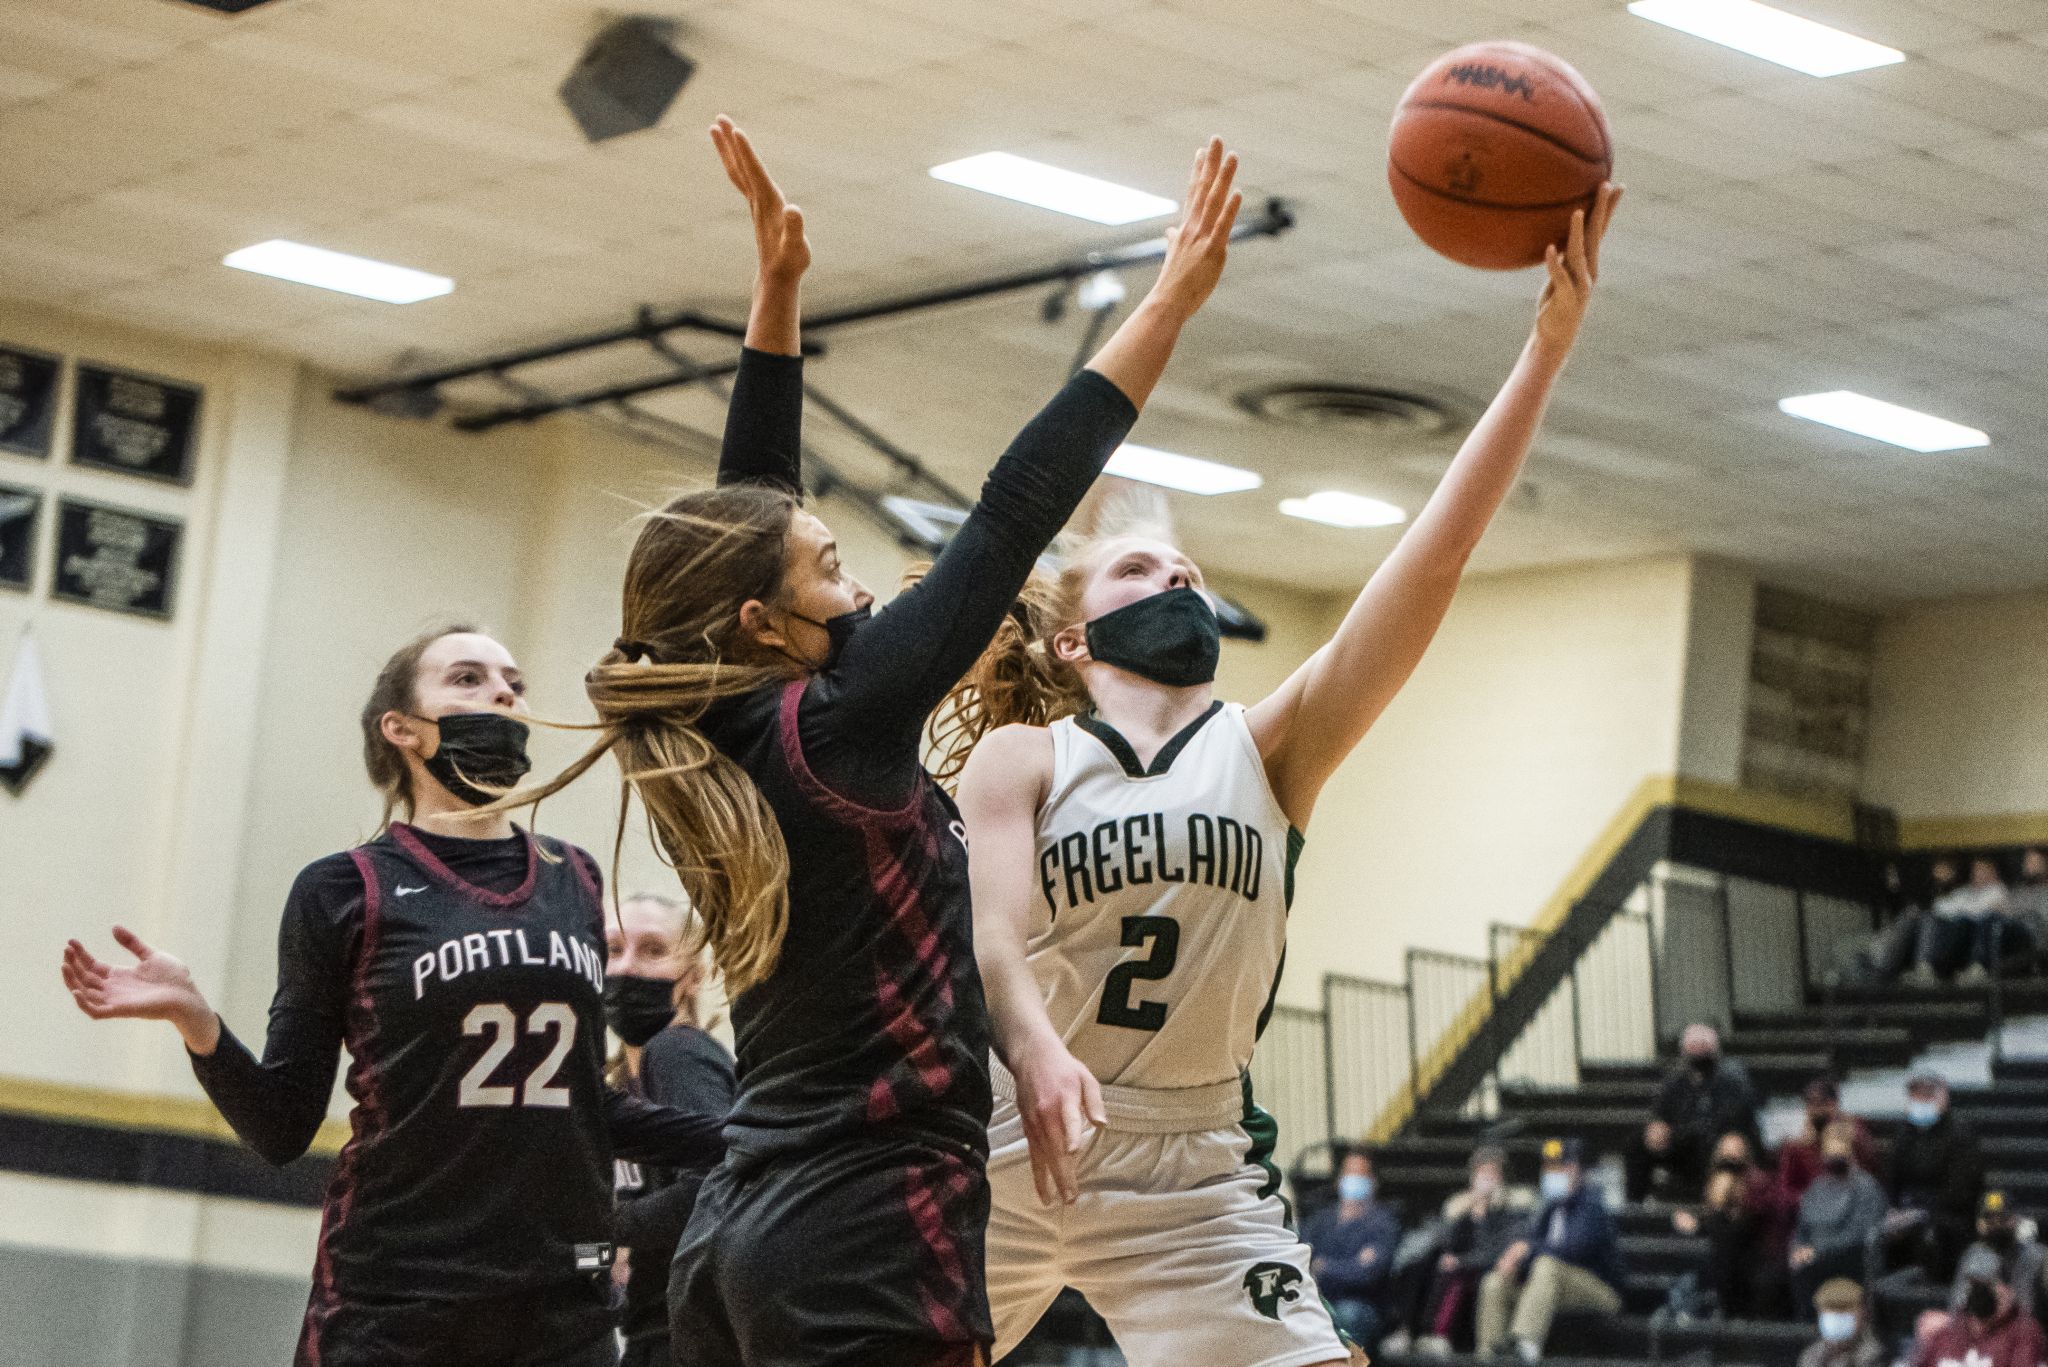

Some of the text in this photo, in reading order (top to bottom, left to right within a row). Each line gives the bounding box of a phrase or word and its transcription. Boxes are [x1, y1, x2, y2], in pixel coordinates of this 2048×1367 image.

[1040, 812, 1263, 922] FREELAND
[412, 928, 604, 1000] PORTLAND
[1097, 915, 1180, 1031] 2
[459, 1003, 577, 1107] 22
